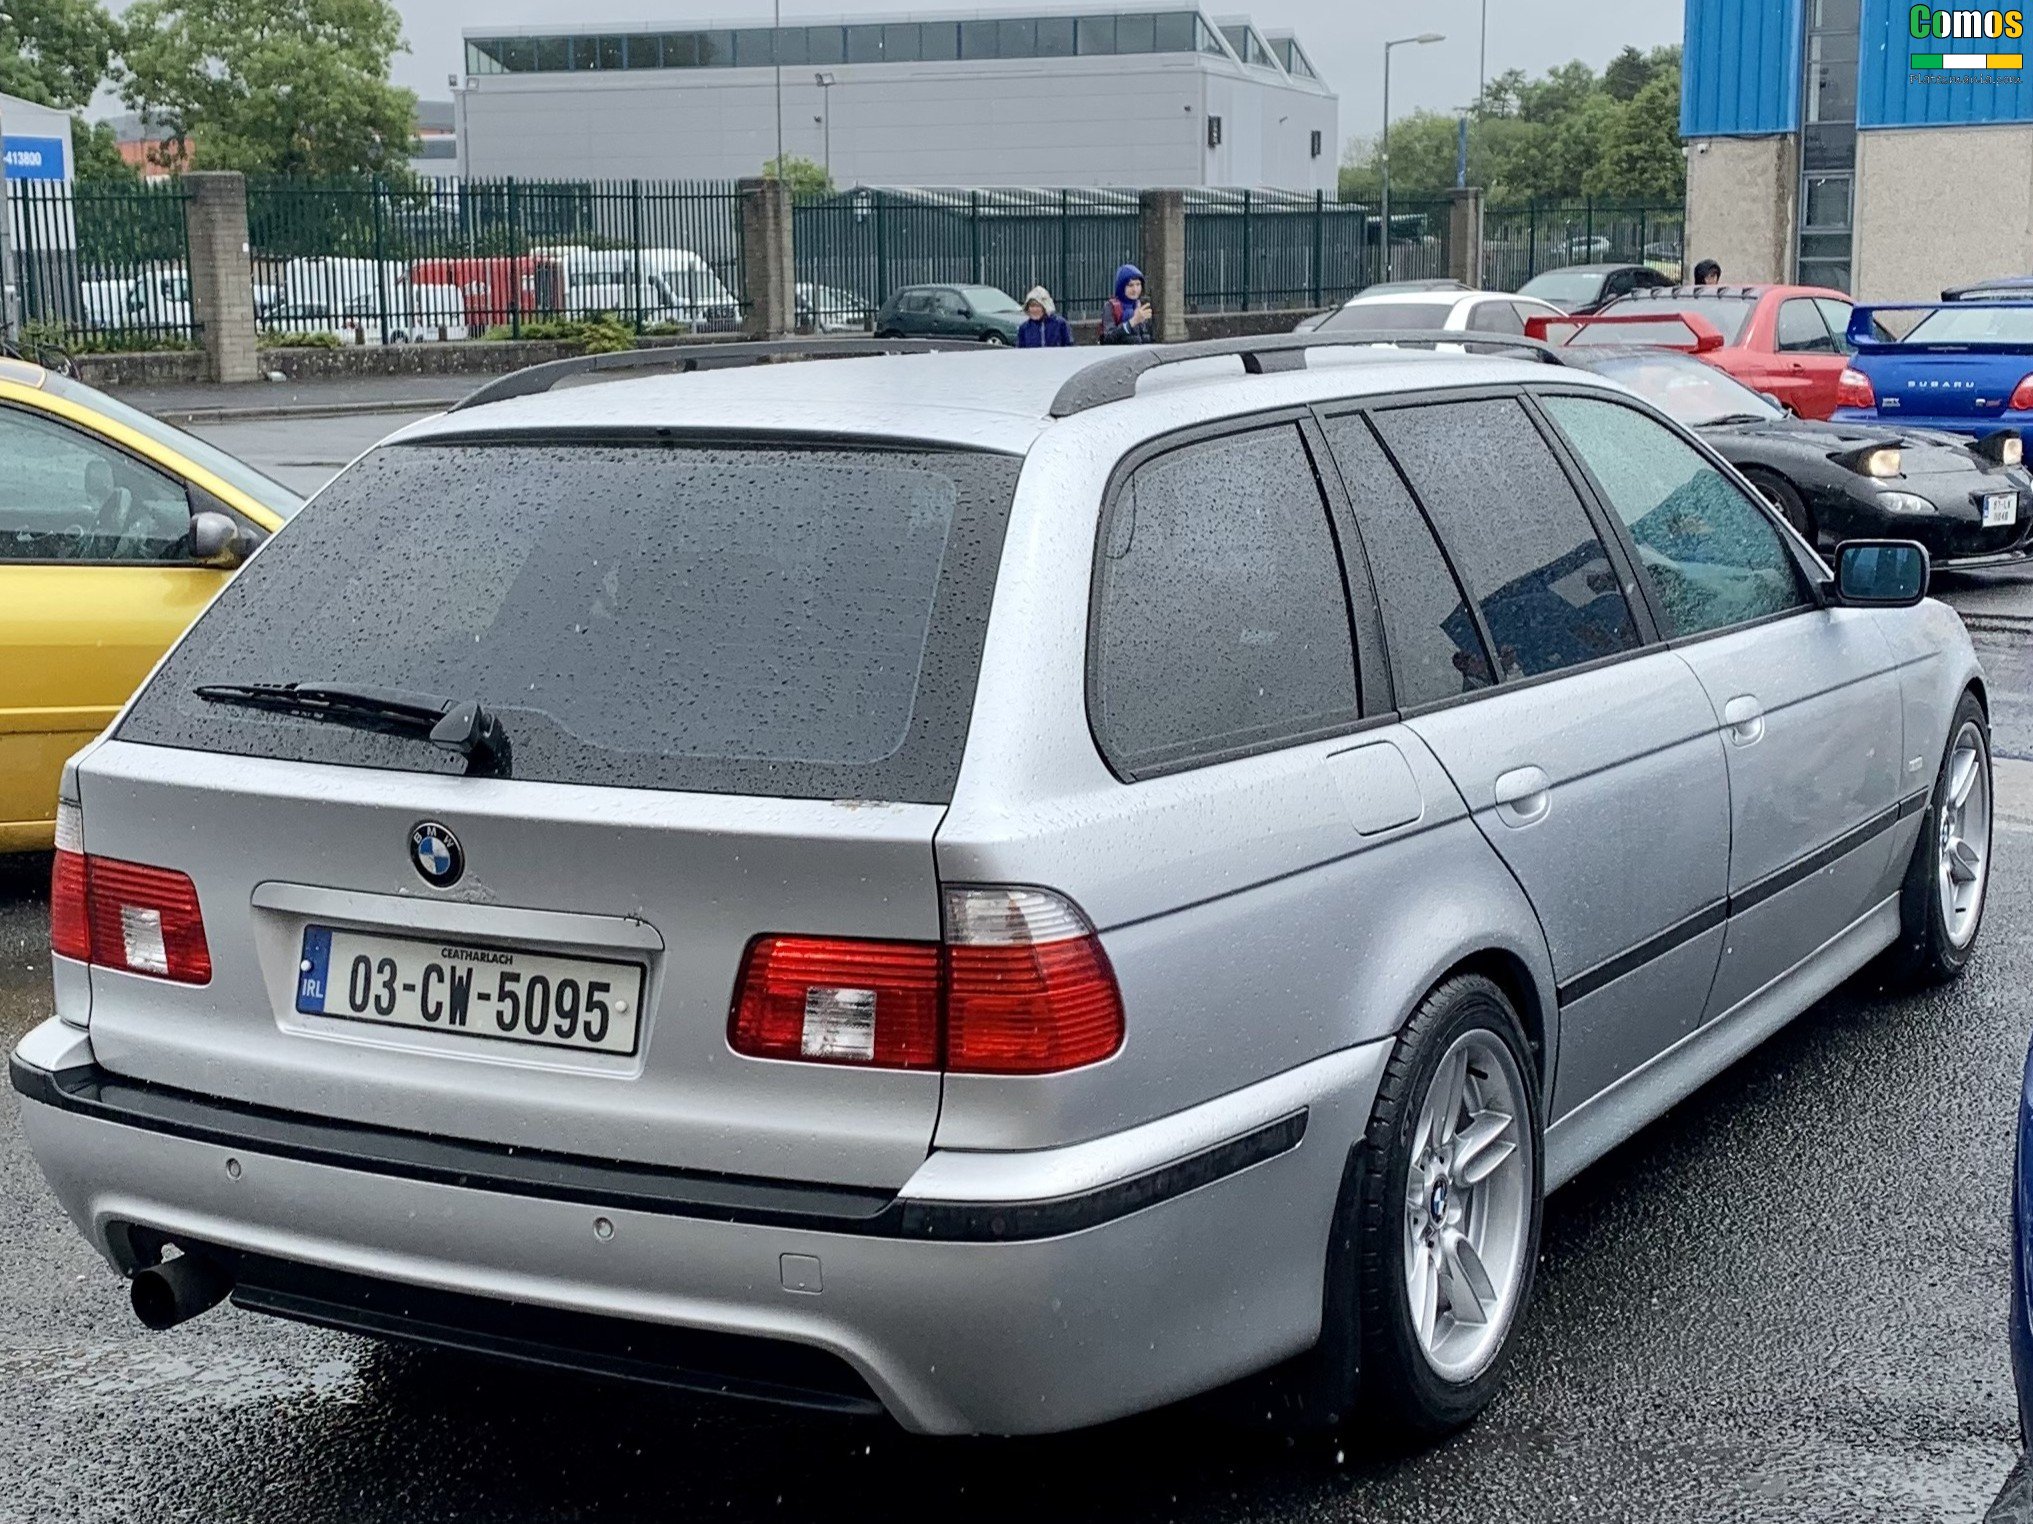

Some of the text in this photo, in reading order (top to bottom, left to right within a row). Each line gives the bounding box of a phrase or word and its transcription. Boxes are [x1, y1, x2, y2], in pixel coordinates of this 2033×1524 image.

[1907, 380, 1975, 388] SUBARU
[413, 826, 454, 848] BMW
[441, 947, 513, 966] CEATHARLACH
[302, 978, 324, 999] IRL
[348, 954, 612, 1043] 03-CW-5095
